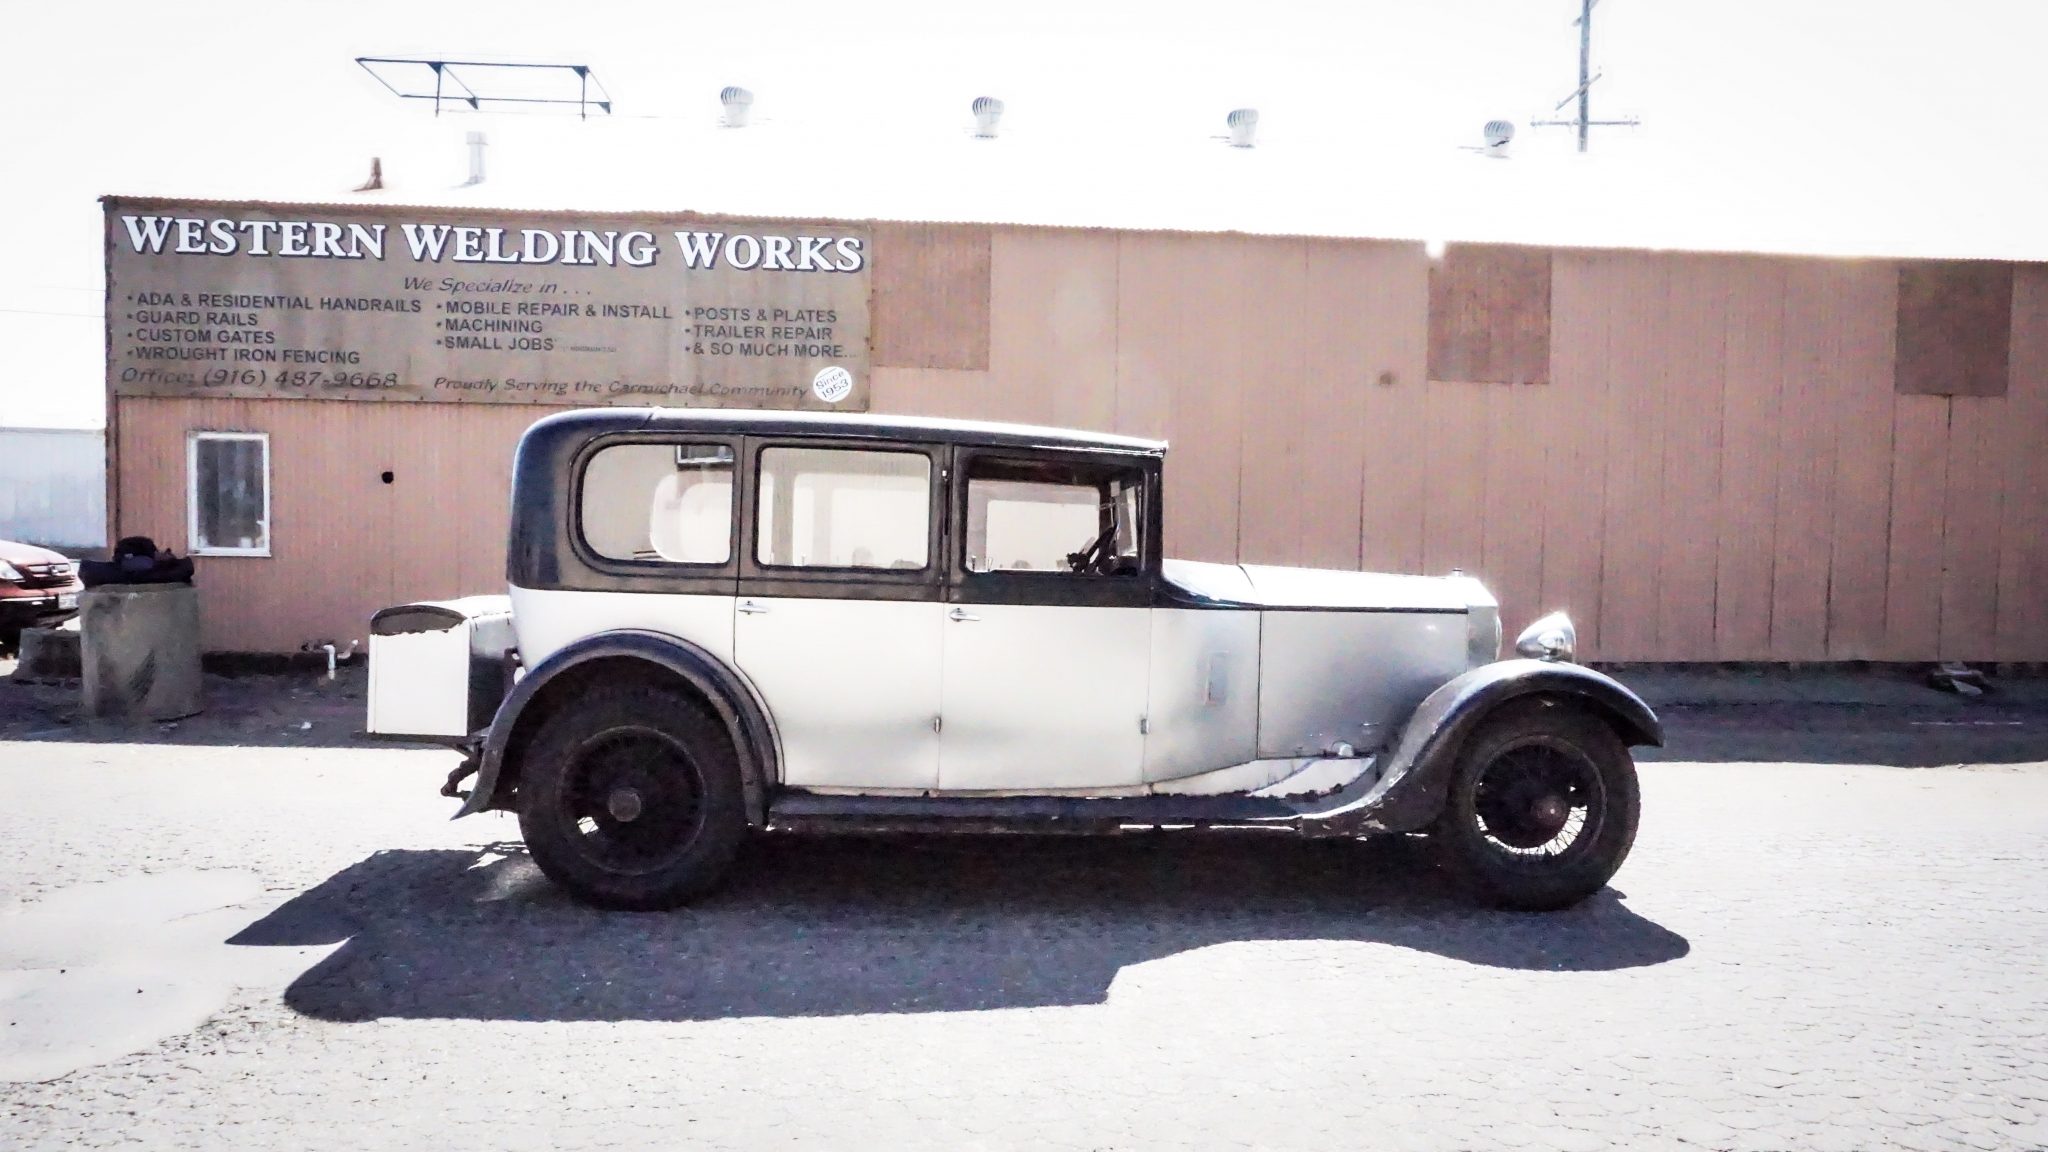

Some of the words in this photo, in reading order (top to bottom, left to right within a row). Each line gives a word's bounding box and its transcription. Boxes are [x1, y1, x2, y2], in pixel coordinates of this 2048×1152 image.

[122, 215, 386, 261] WESTERN
[401, 224, 660, 268] WELDING
[674, 231, 864, 273] WORKS
[405, 278, 432, 291] We
[439, 278, 533, 295] Specialize
[137, 293, 176, 307] ADA
[181, 294, 192, 307] &
[199, 295, 314, 310] RESIDENTIAL
[320, 297, 421, 313] HANDRAILS
[446, 302, 513, 316] MOBILE
[518, 303, 580, 317] REPAIR
[585, 304, 597, 317] &
[602, 305, 672, 319] INSTALL
[137, 311, 200, 325] GUARD
[207, 312, 258, 326] RAILS
[695, 307, 750, 321] POSTS
[757, 308, 767, 321] &
[774, 309, 837, 323] PLATES
[445, 319, 543, 333] MACHINING
[693, 325, 766, 339] TRAILER
[772, 326, 832, 340] REPAIR
[137, 328, 211, 343] CUSTOM
[217, 330, 274, 344] GATES
[445, 336, 502, 350] SMALL
[509, 337, 554, 351] JOBS
[137, 347, 227, 361] WROUGHT
[234, 348, 276, 363] IRON
[283, 350, 360, 365] FENCING
[693, 343, 704, 355] &
[710, 343, 733, 355] SO
[740, 344, 788, 357] MUCH
[203, 369, 266, 388] (916)
[275, 371, 398, 389] 487-9668
[434, 377, 498, 392] Proudly
[504, 378, 568, 395] Serving
[575, 380, 602, 392] the
[608, 380, 704, 395] Carmichael
[709, 383, 808, 398] Community
[815, 371, 844, 389] Since
[822, 378, 849, 398] 1953
